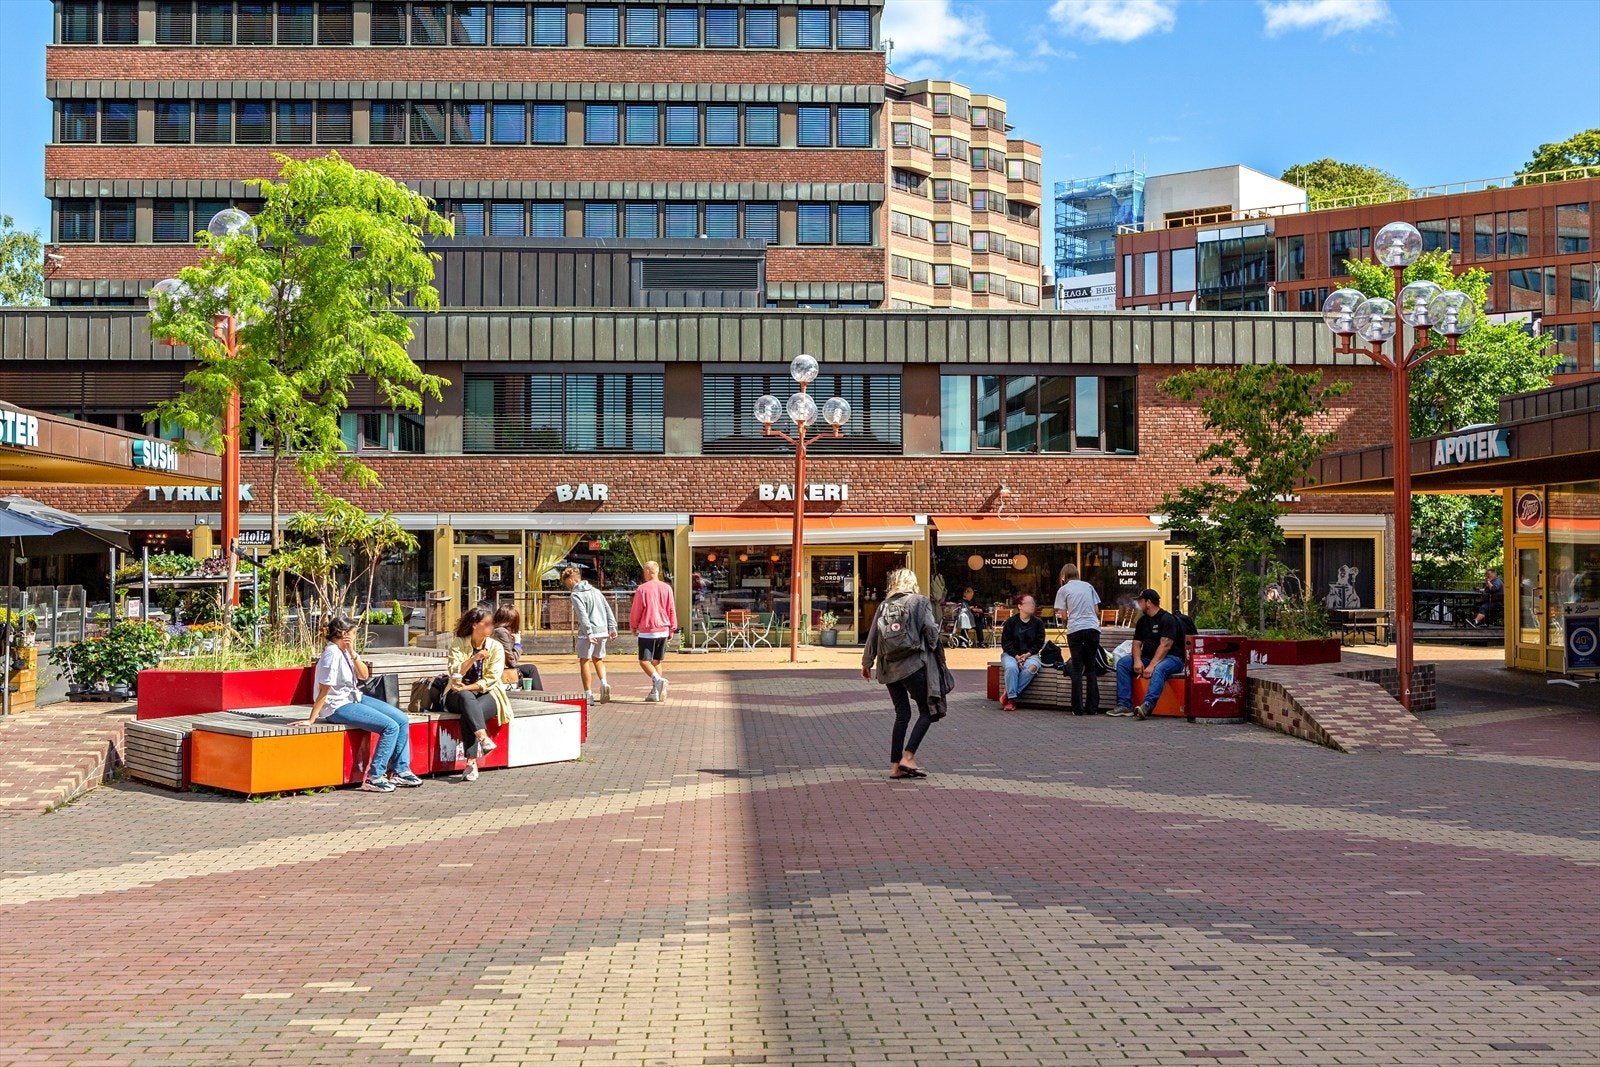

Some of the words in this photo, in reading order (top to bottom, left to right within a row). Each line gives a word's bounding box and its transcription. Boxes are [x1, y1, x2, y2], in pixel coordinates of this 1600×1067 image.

[1063, 289, 1088, 297] HAGA
[143, 440, 178, 470] SUSHI
[1434, 429, 1500, 465] APOTEK
[145, 484, 254, 501] TYRKIK
[556, 483, 609, 502] BAR
[239, 531, 270, 541] atolia
